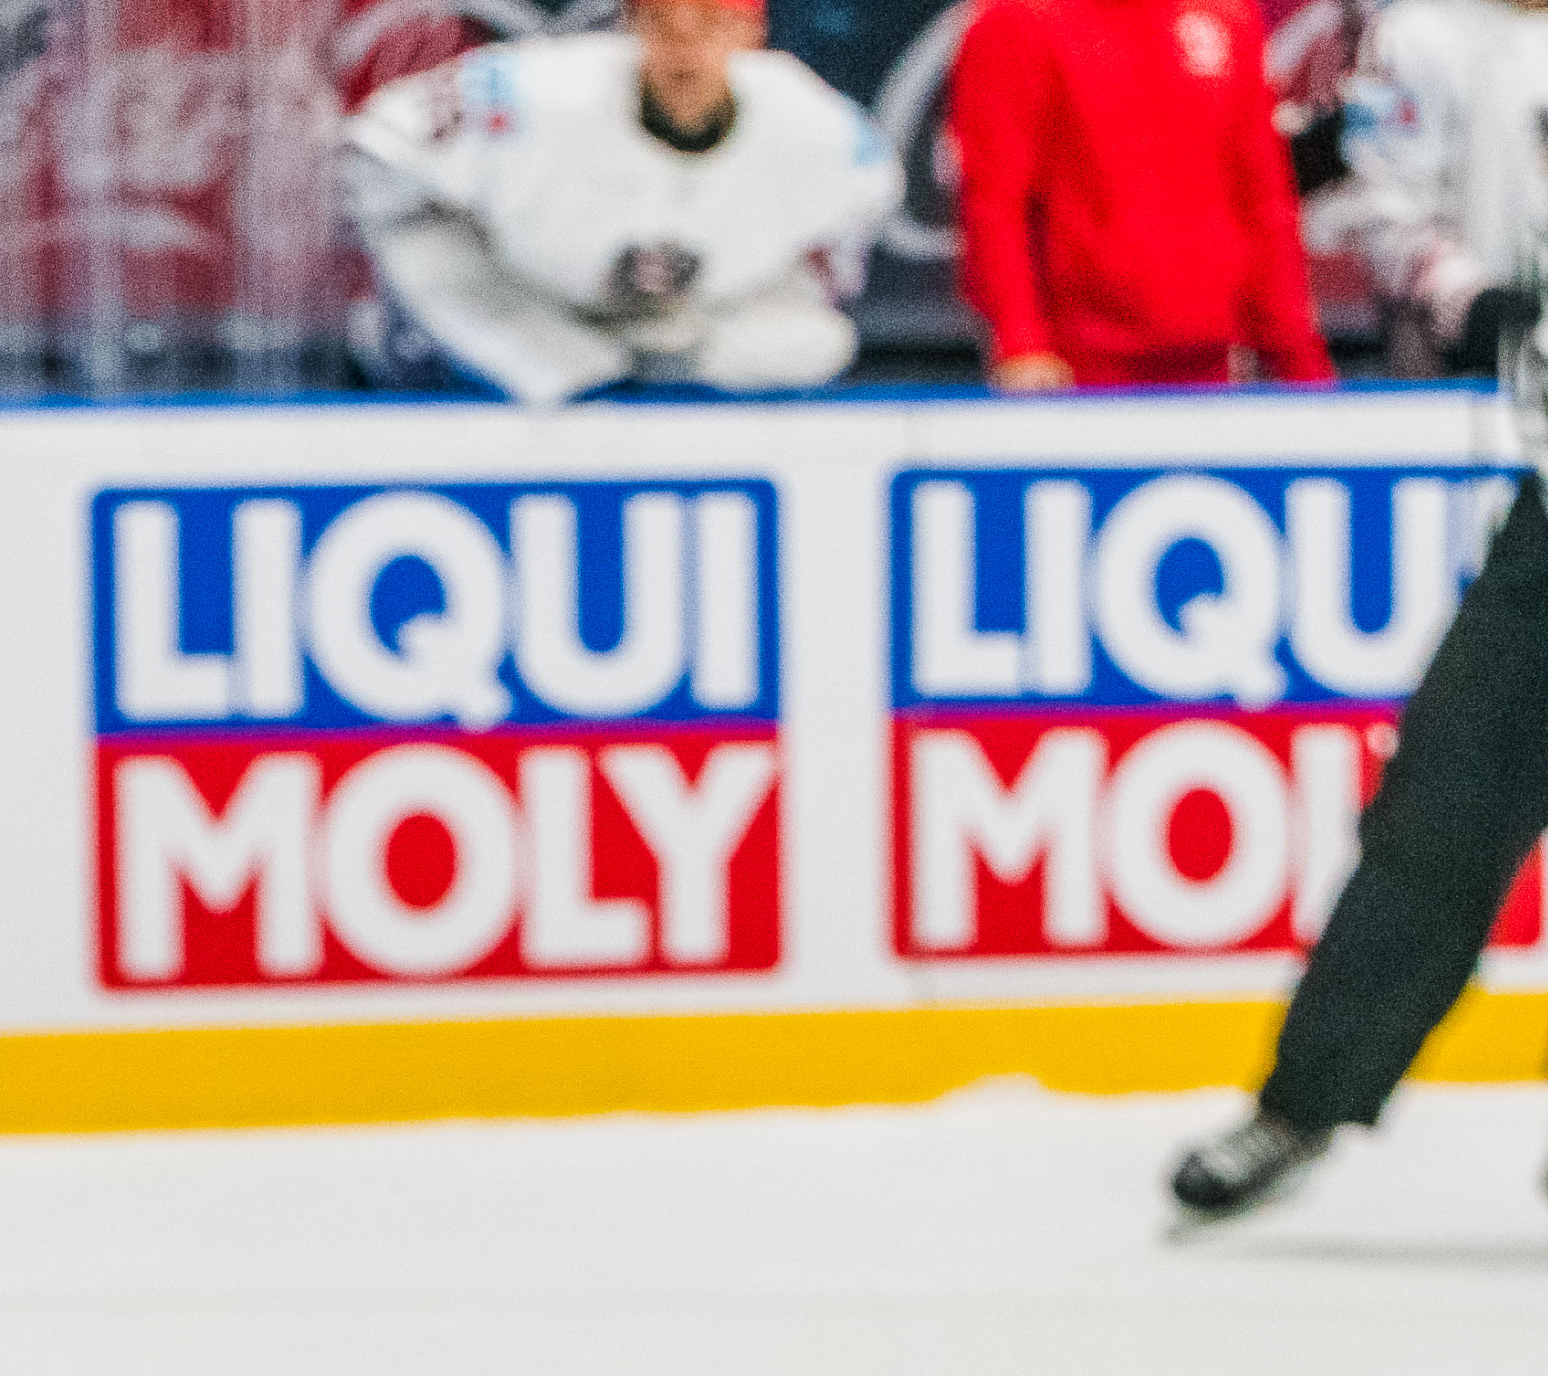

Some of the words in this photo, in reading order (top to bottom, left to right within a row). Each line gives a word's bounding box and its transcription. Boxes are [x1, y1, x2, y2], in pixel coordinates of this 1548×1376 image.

[112, 490, 758, 733] LIQUI
[112, 743, 778, 980] MOLY
[911, 718, 1398, 950] MOL
